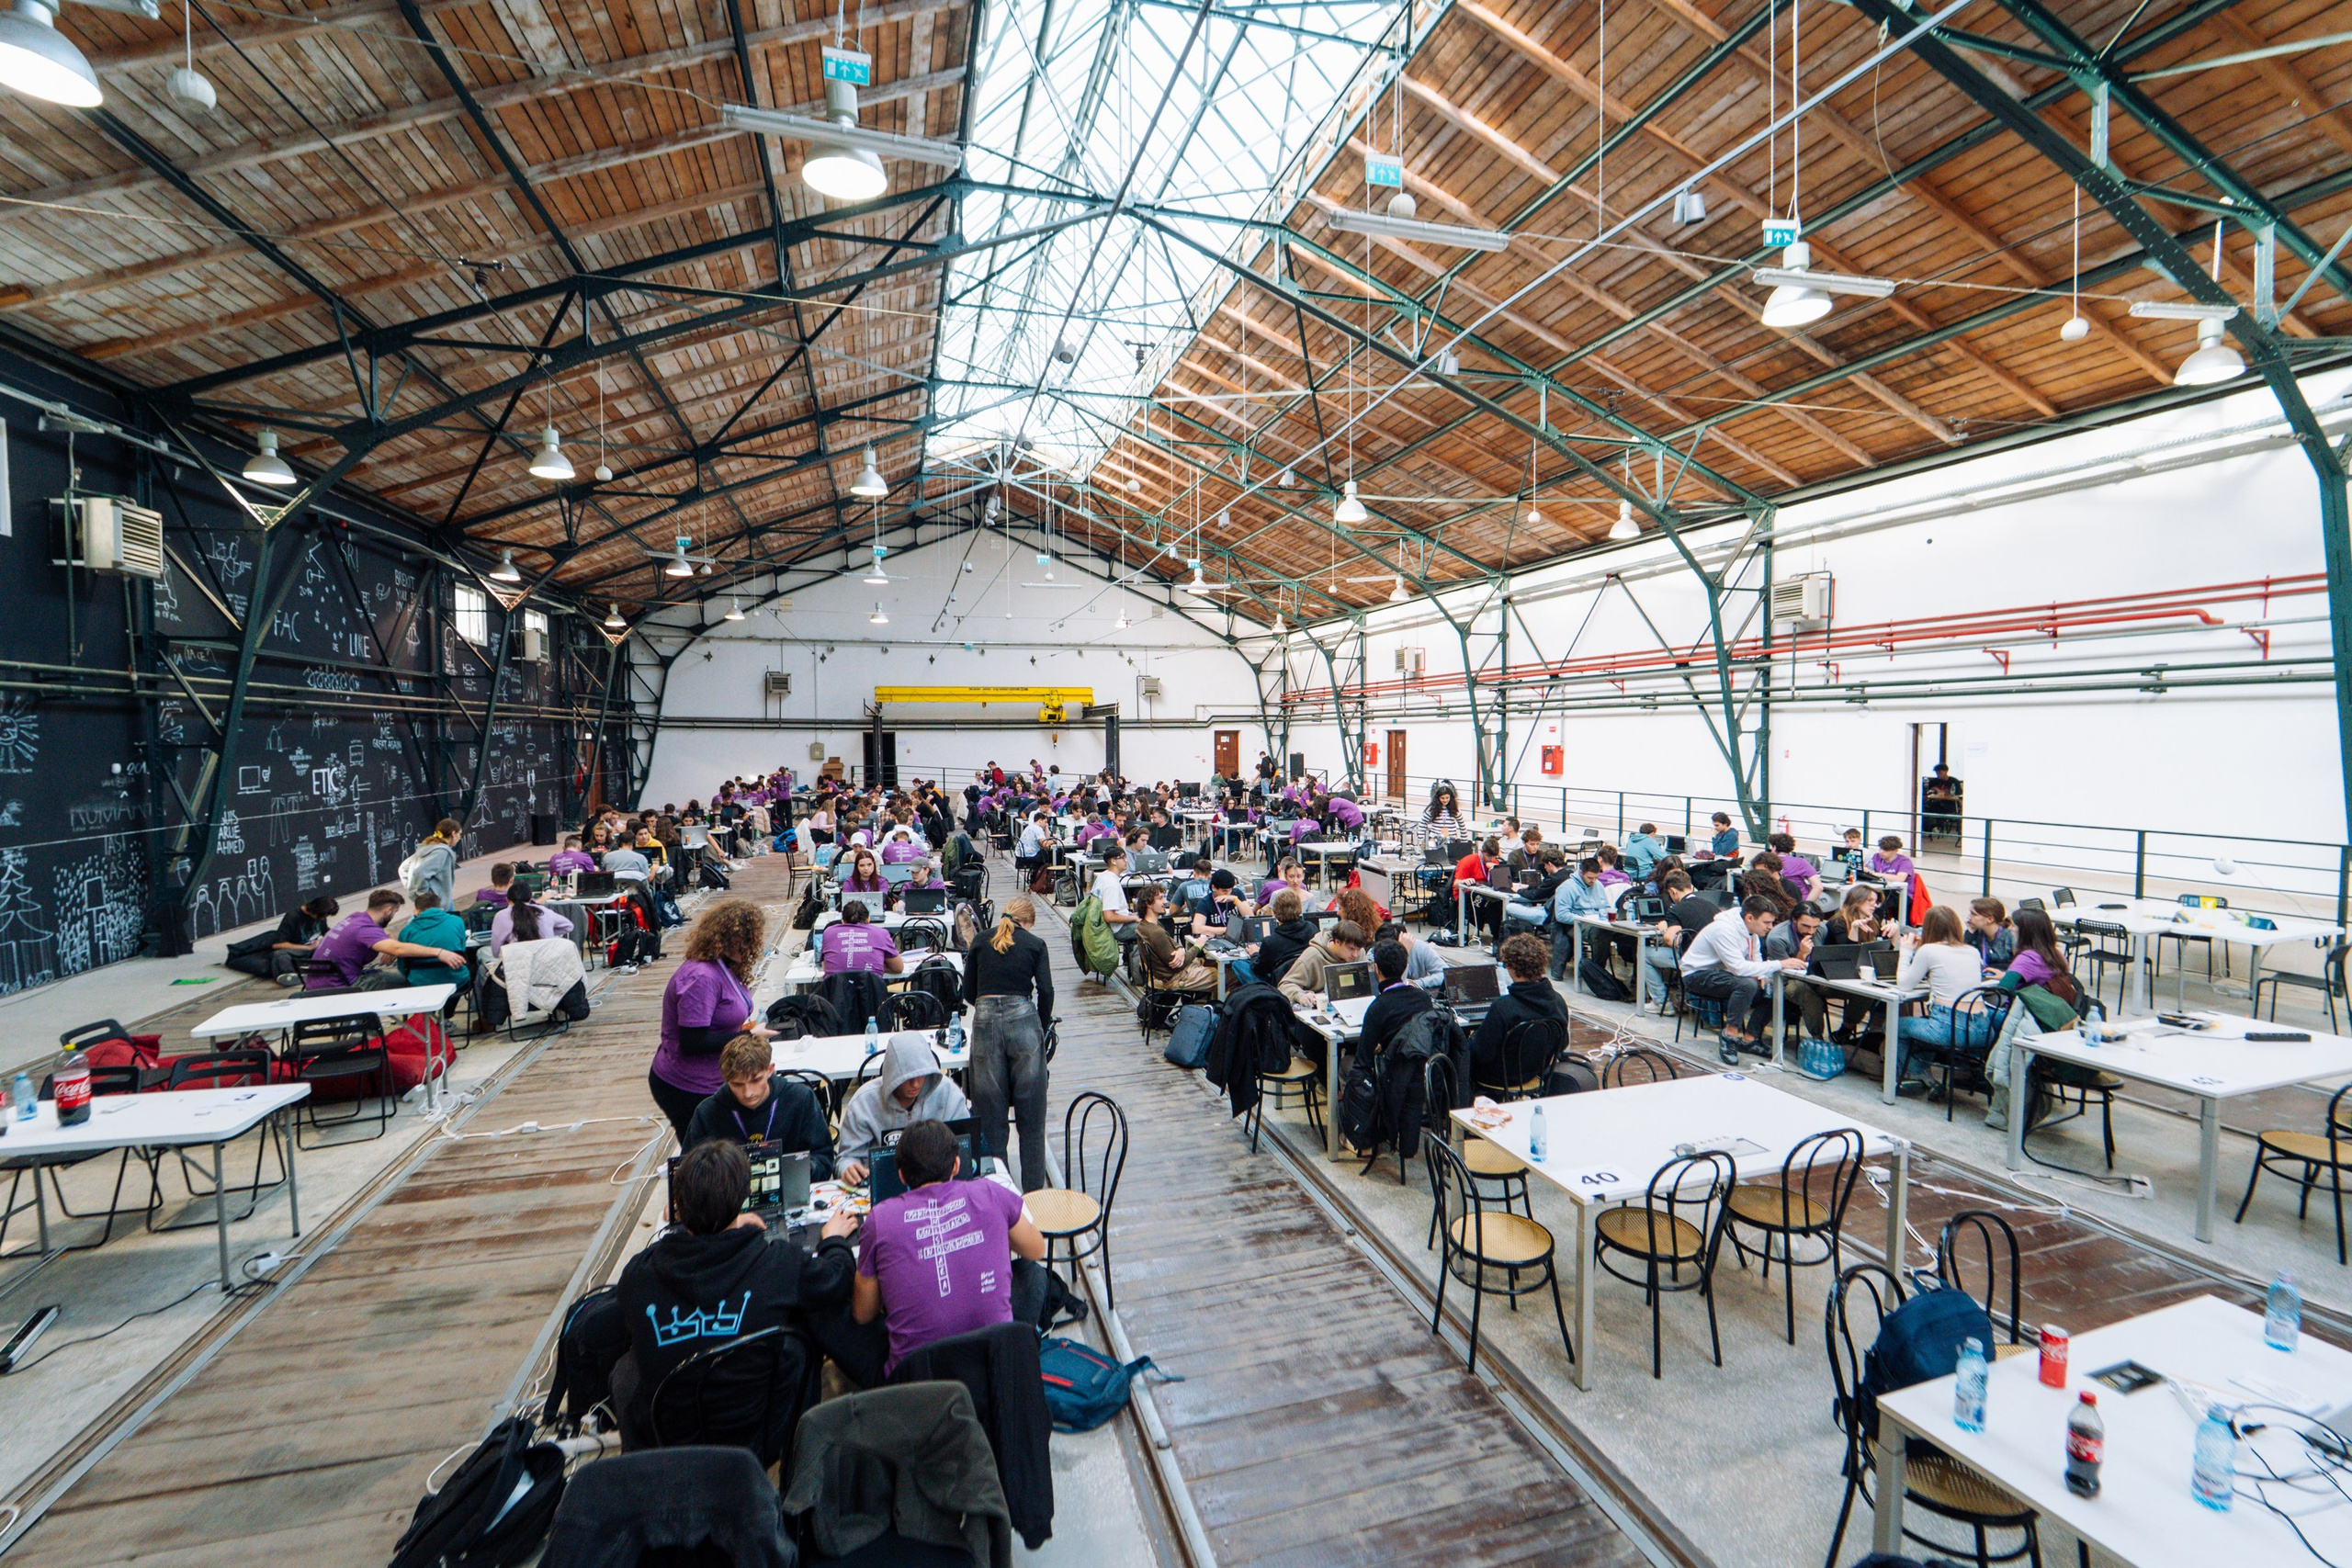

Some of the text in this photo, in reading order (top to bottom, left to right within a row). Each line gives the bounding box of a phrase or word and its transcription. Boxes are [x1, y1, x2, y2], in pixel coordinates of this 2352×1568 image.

[349, 633, 371, 659] LIKE
[373, 713, 394, 726] MAKE
[312, 767, 338, 795] ETIC
[1581, 1172, 1620, 1185] 40
